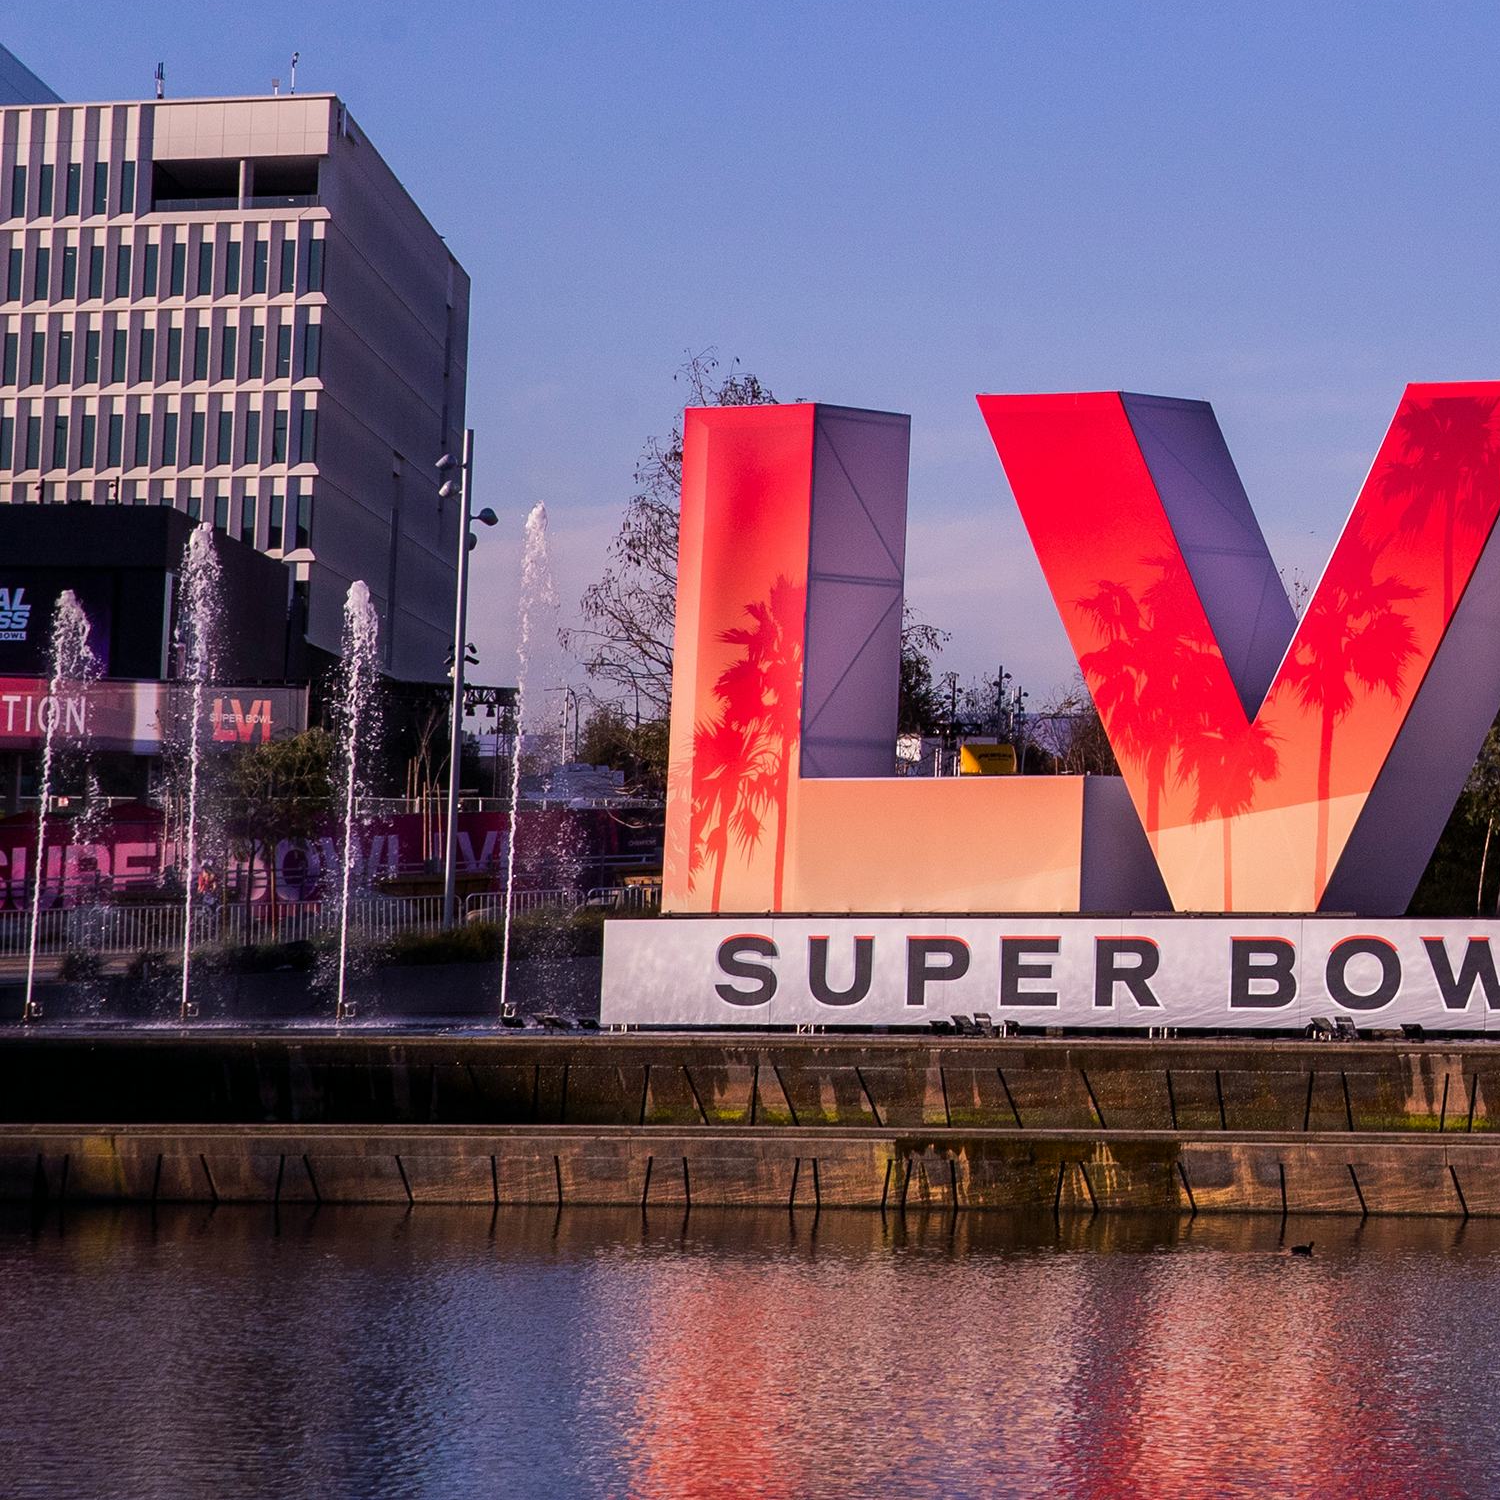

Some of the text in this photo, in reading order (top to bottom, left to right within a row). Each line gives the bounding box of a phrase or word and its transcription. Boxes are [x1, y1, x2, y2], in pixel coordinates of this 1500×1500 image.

[208, 712, 275, 725] SUPER BOWL
[212, 698, 272, 744] LVI
[714, 932, 1165, 1010] SUPER
